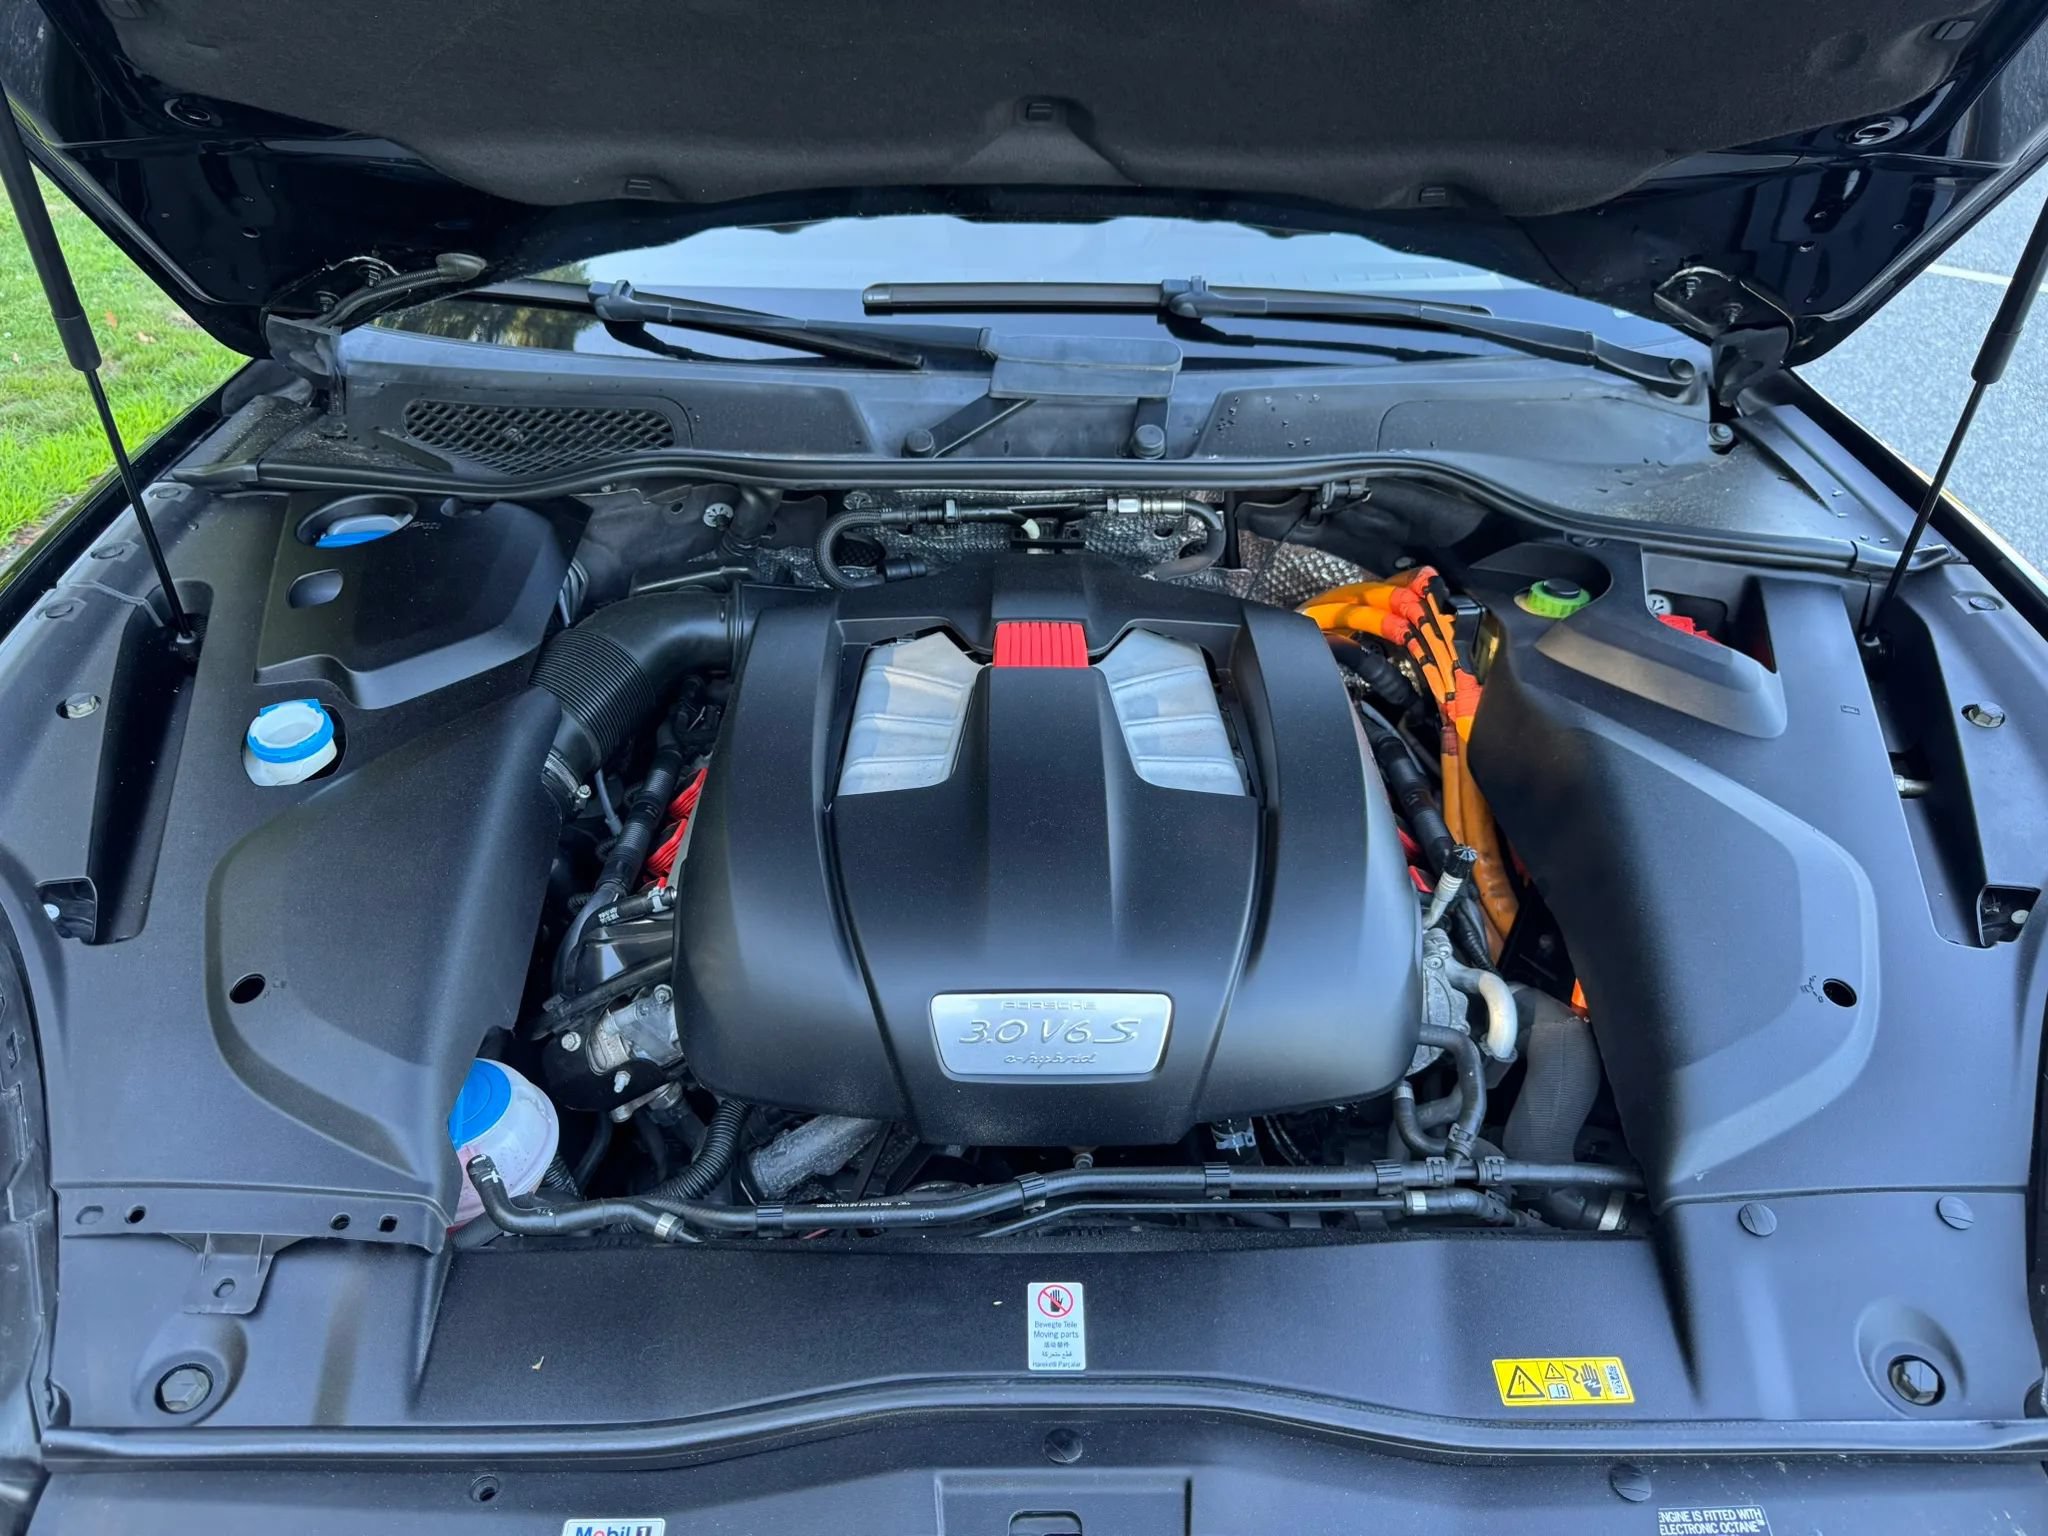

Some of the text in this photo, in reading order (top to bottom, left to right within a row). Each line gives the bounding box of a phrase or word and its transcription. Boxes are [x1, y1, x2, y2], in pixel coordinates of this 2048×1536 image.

[1003, 1000, 1096, 1010] PORSCHE
[959, 1018, 1142, 1044] 3.0 V6 S
[1004, 1053, 1096, 1070] e-hybrid
[1033, 1330, 1079, 1339] Moving parts
[1691, 1511, 1703, 1522] IS
[1703, 1509, 1737, 1521] FITTED
[1736, 1508, 1763, 1520] WITH
[1659, 1522, 1719, 1536] ELECTRONIC
